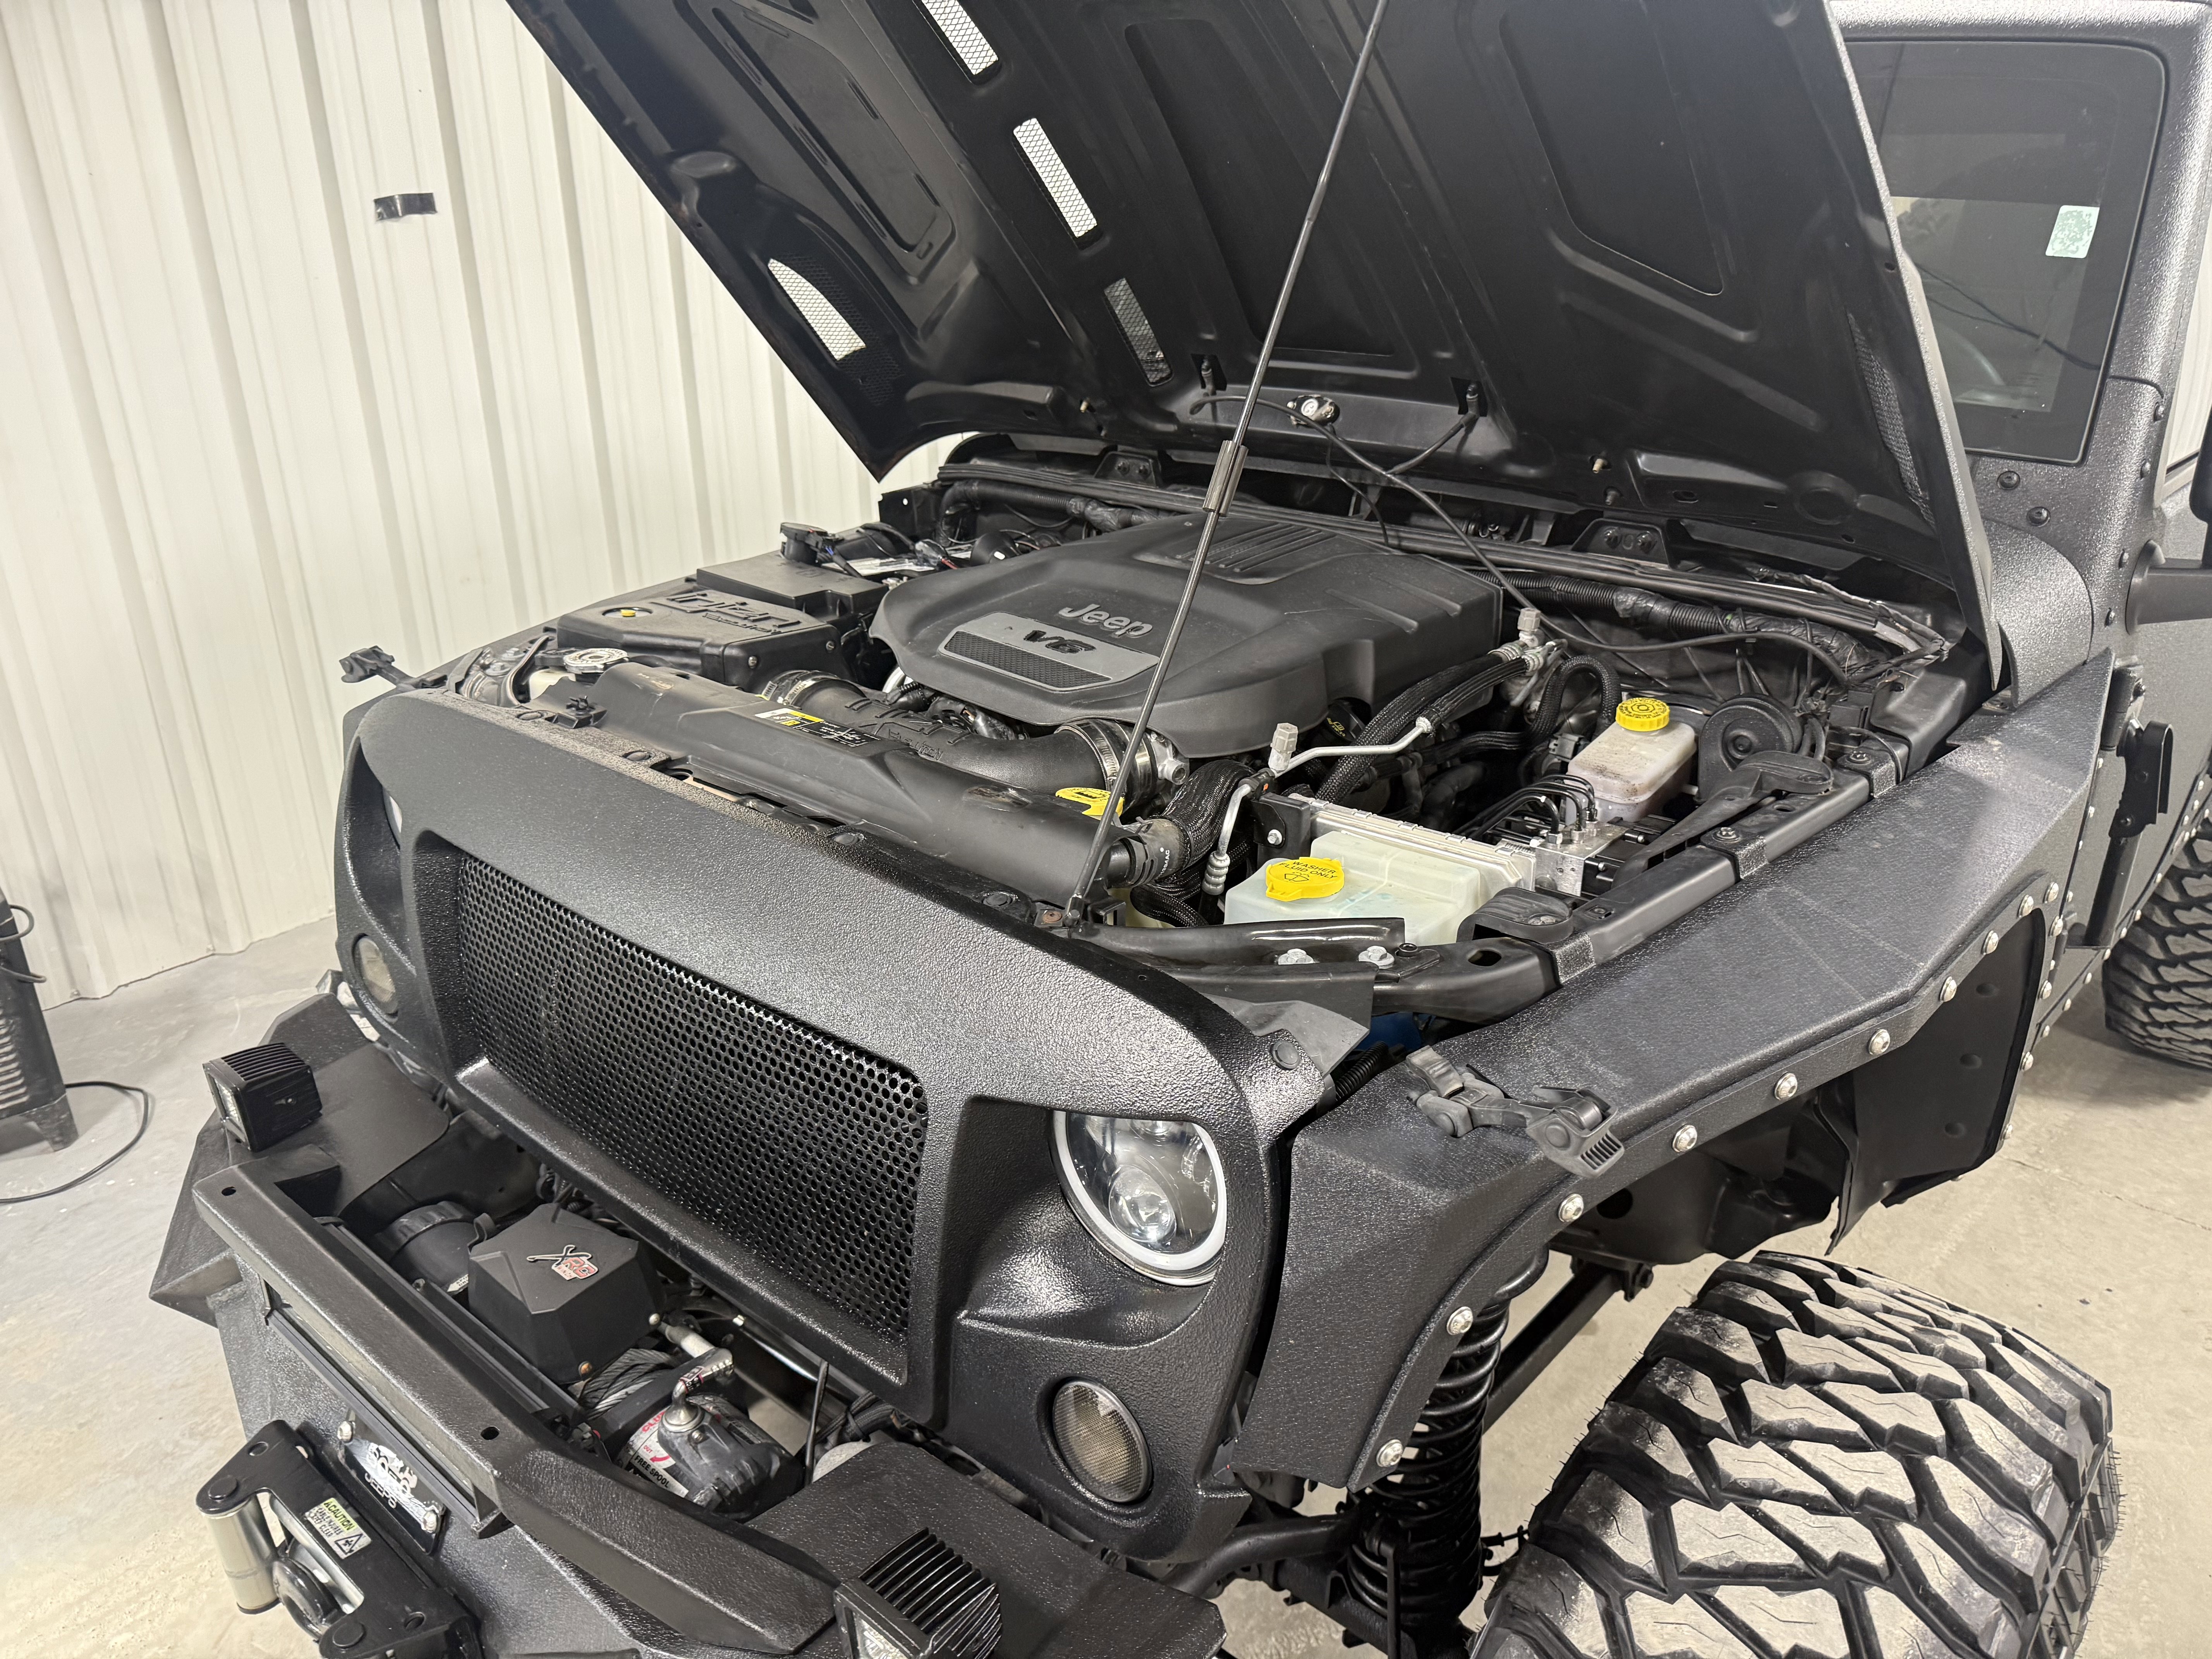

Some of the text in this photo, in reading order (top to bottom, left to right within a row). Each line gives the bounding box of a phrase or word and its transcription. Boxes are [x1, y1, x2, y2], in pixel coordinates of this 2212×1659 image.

[1058, 604, 1153, 637] Jeep
[1024, 630, 1096, 654] V6
[1279, 863, 1338, 879] FLUID ONLY
[1293, 861, 1336, 874] WASHER
[527, 1245, 597, 1278] XRC
[634, 1455, 670, 1488] FREE SPOOL
